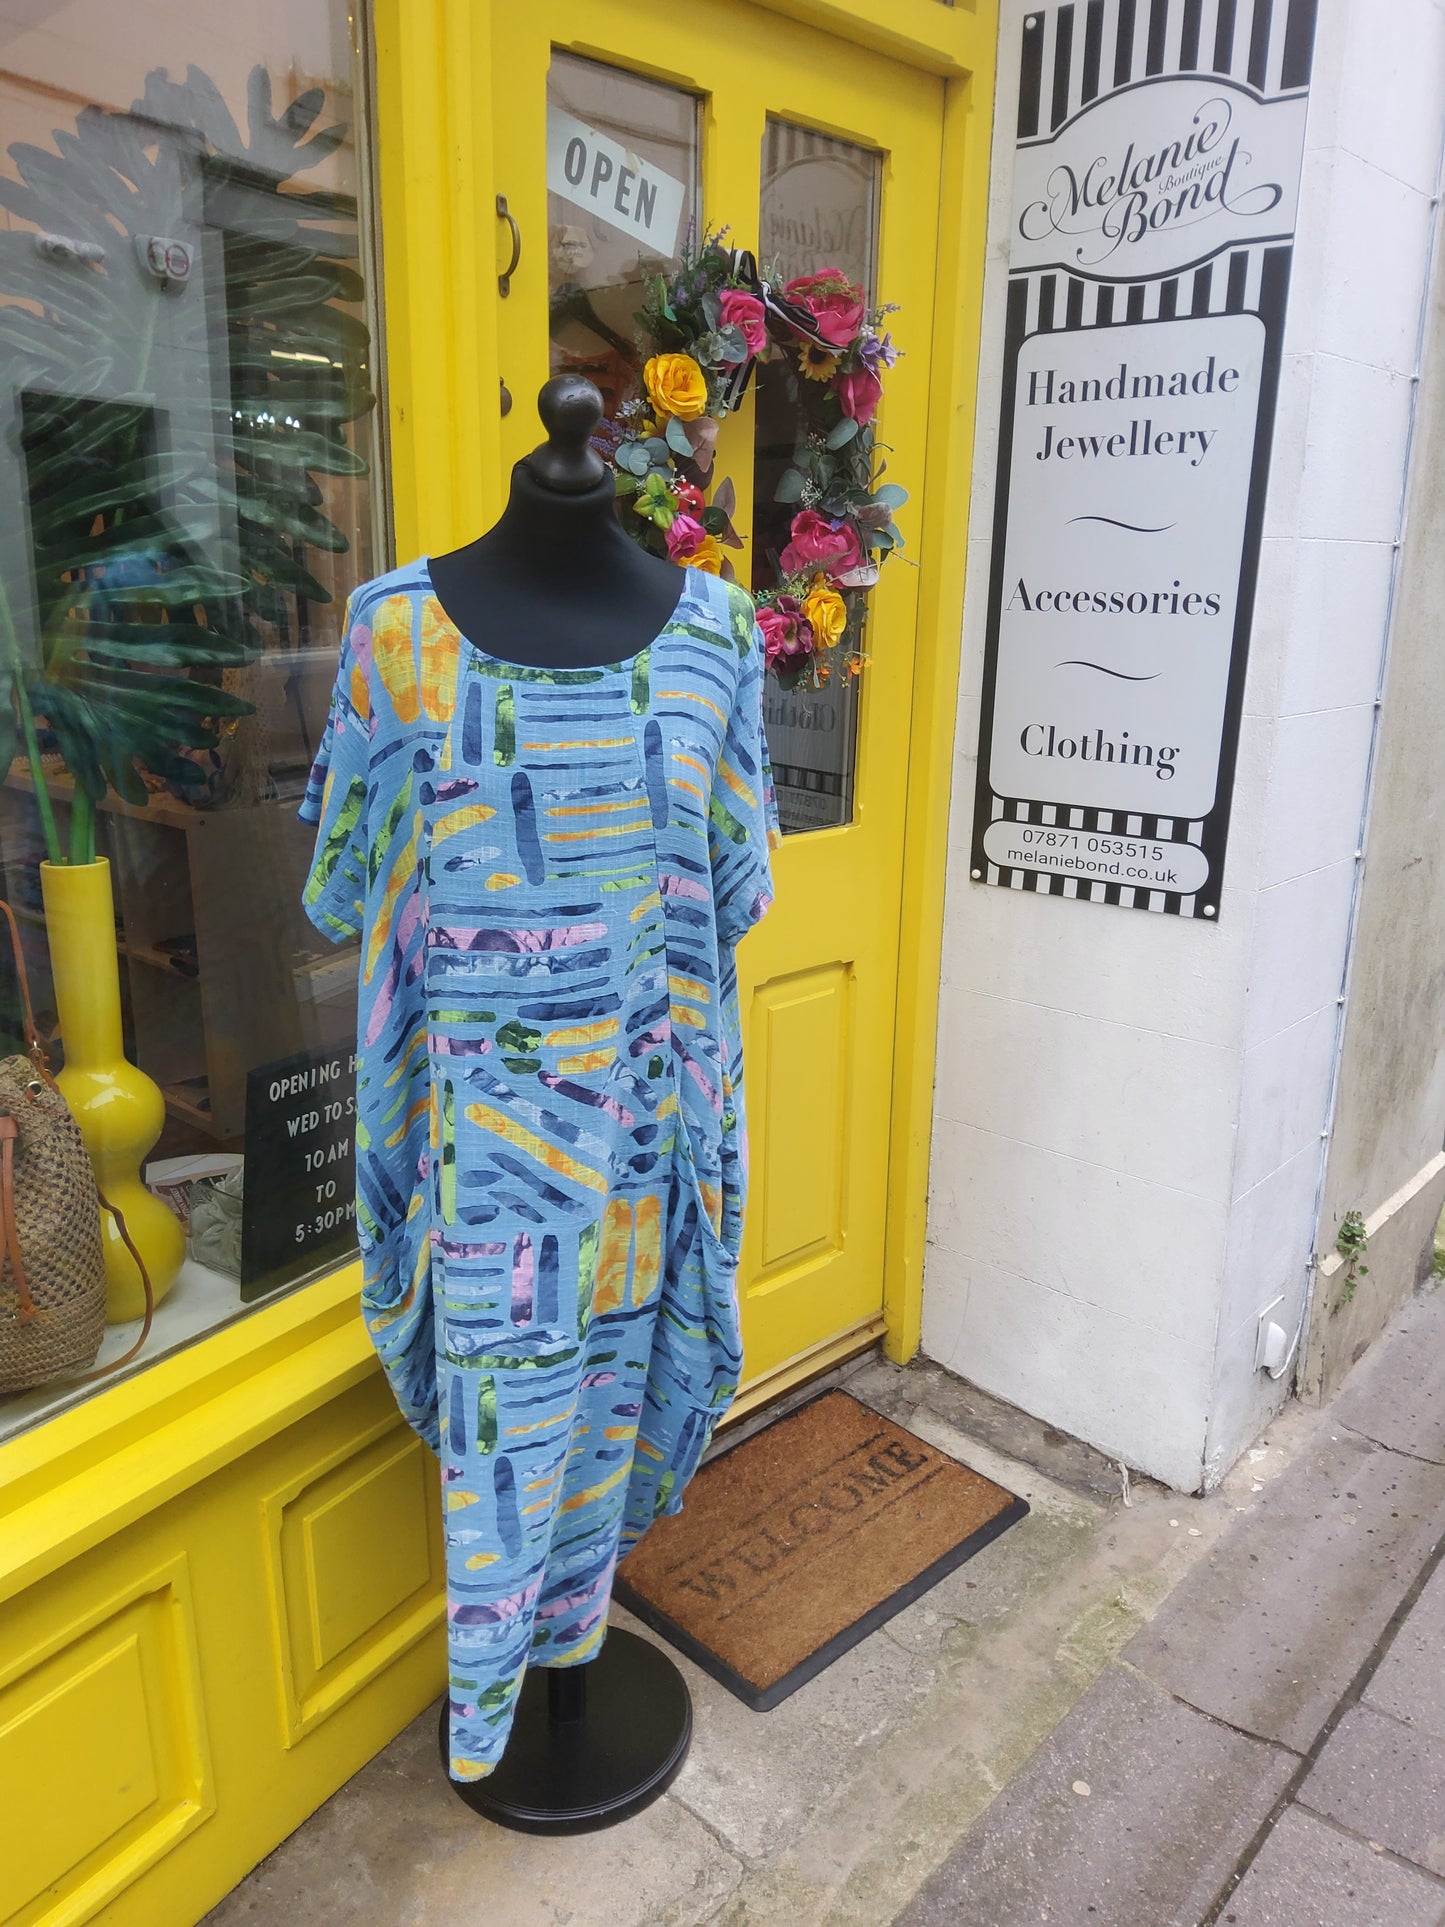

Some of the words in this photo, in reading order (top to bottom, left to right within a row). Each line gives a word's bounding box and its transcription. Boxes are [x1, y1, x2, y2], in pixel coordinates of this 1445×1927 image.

[564, 137, 657, 229] OPEN
[1019, 98, 1232, 240] Melanie
[1158, 155, 1224, 195] Boutique
[1077, 137, 1282, 264] Bond
[1026, 356, 1240, 407] Handmade
[1036, 419, 1218, 467] Jewellery
[1004, 577, 1222, 616] Accessories
[1019, 723, 1180, 781] Clothing
[1007, 847, 1178, 884] melaniebond.co.uk
[1022, 829, 1079, 850] 07871
[1087, 837, 1164, 861] 053515
[269, 1061, 341, 1102] OPENING
[286, 1111, 319, 1138] WED
[324, 1102, 343, 1124] TO
[316, 1180, 337, 1203] TO
[295, 1200, 356, 1243] 5:30PM
[678, 1441, 929, 1601] WELCOME
